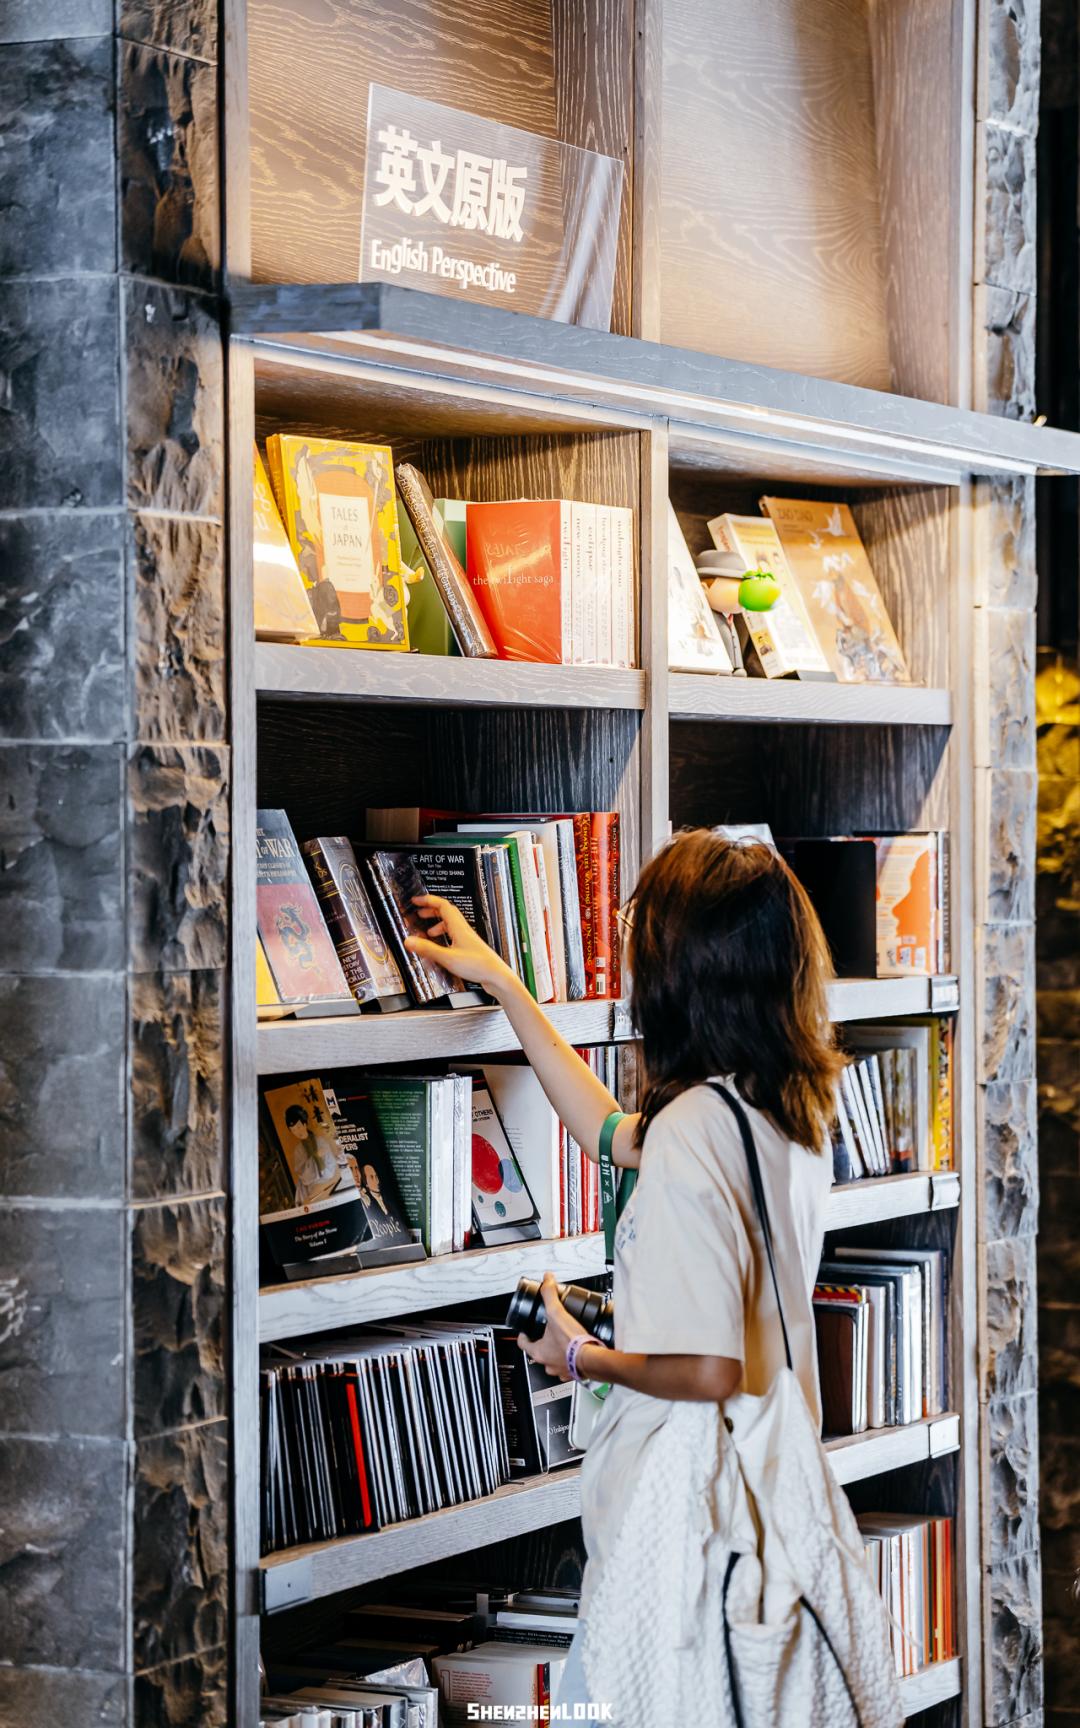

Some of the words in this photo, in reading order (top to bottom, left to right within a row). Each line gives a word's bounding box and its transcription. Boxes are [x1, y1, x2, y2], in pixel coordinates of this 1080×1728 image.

[374, 125, 528, 242] 英文原版
[370, 237, 427, 274] English
[432, 247, 516, 293] Perspective
[331, 507, 359, 522] TALES
[331, 533, 363, 548] JAPAN
[472, 573, 487, 586] the
[534, 575, 554, 587] saga
[264, 838, 295, 858] WAR
[420, 854, 433, 863] ART
[435, 854, 445, 863] OF
[447, 855, 465, 864] WAR
[338, 1132, 368, 1144] DERALIST
